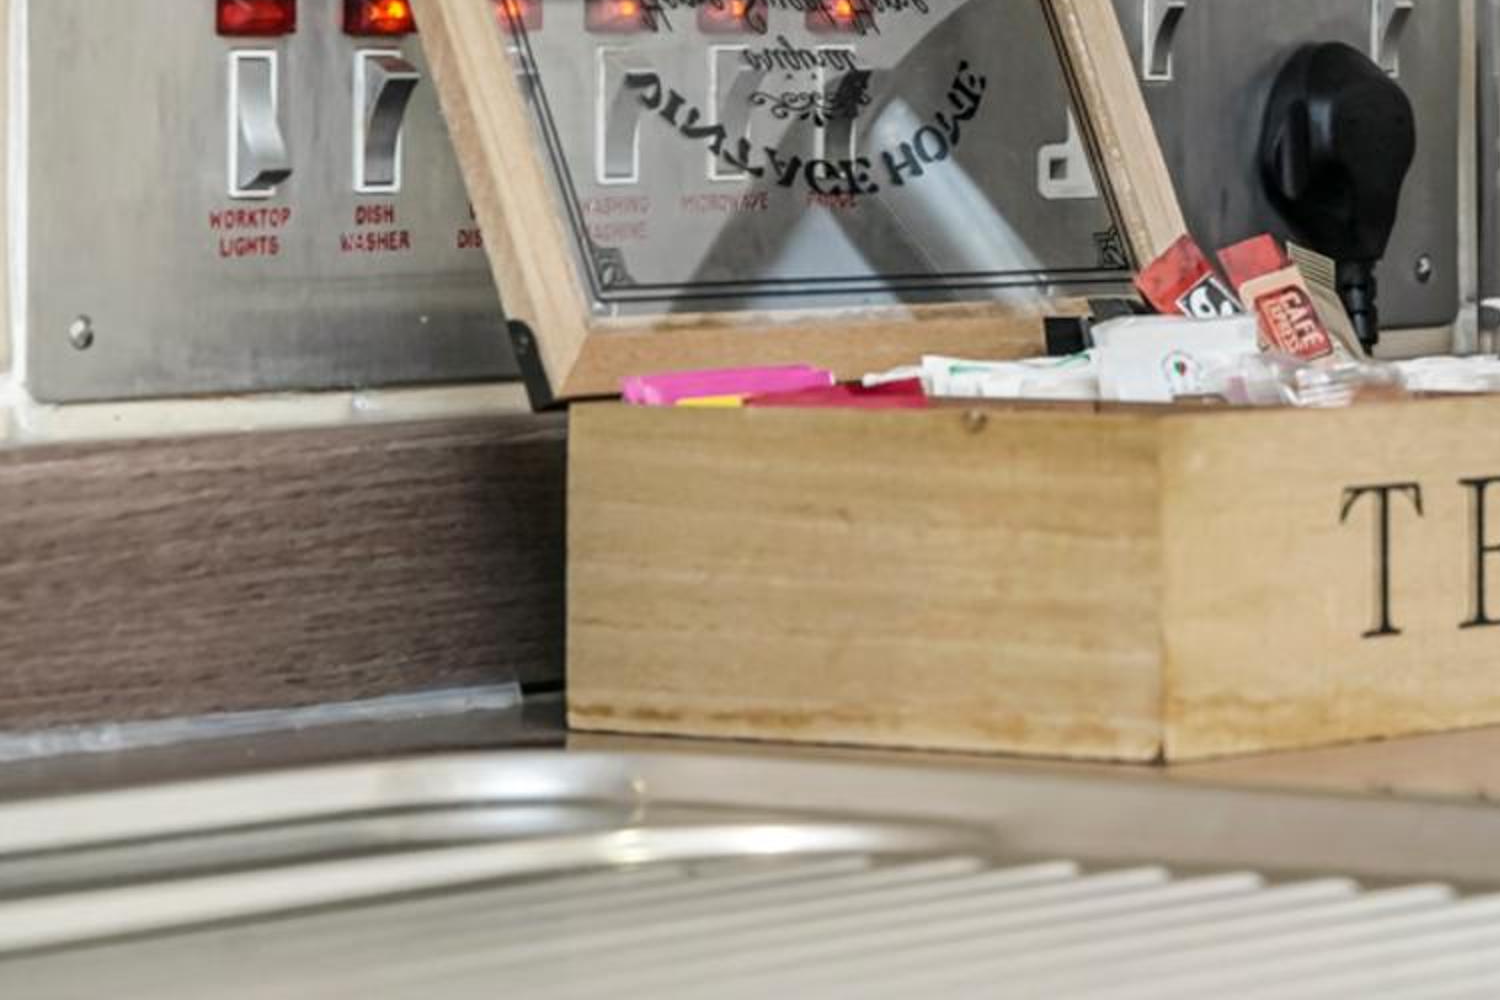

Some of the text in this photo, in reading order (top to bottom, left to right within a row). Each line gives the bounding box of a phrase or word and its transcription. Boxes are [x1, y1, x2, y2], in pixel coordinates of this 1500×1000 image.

[209, 207, 291, 230] WORKTOP
[354, 204, 395, 225] DISH
[219, 235, 280, 258] LIGHTS
